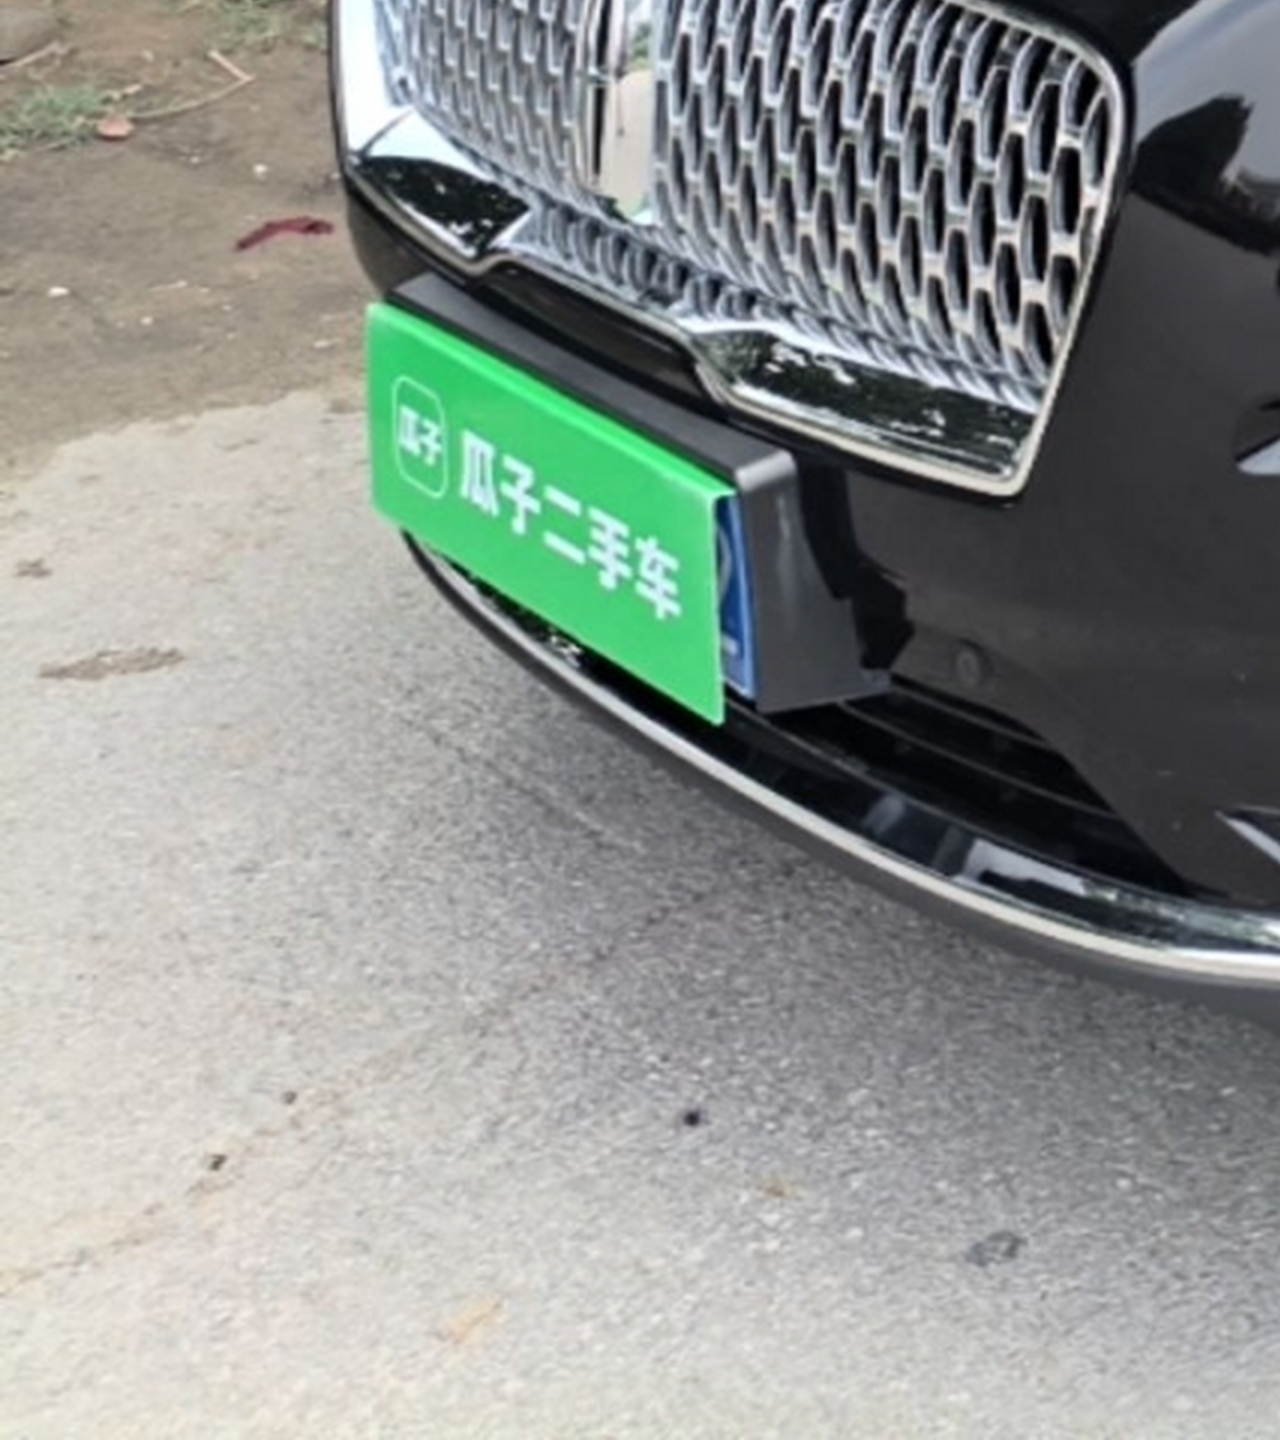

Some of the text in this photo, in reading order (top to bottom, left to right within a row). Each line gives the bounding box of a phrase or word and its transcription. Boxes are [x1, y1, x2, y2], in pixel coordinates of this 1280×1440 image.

[460, 429, 682, 622] 瓜子二手车
